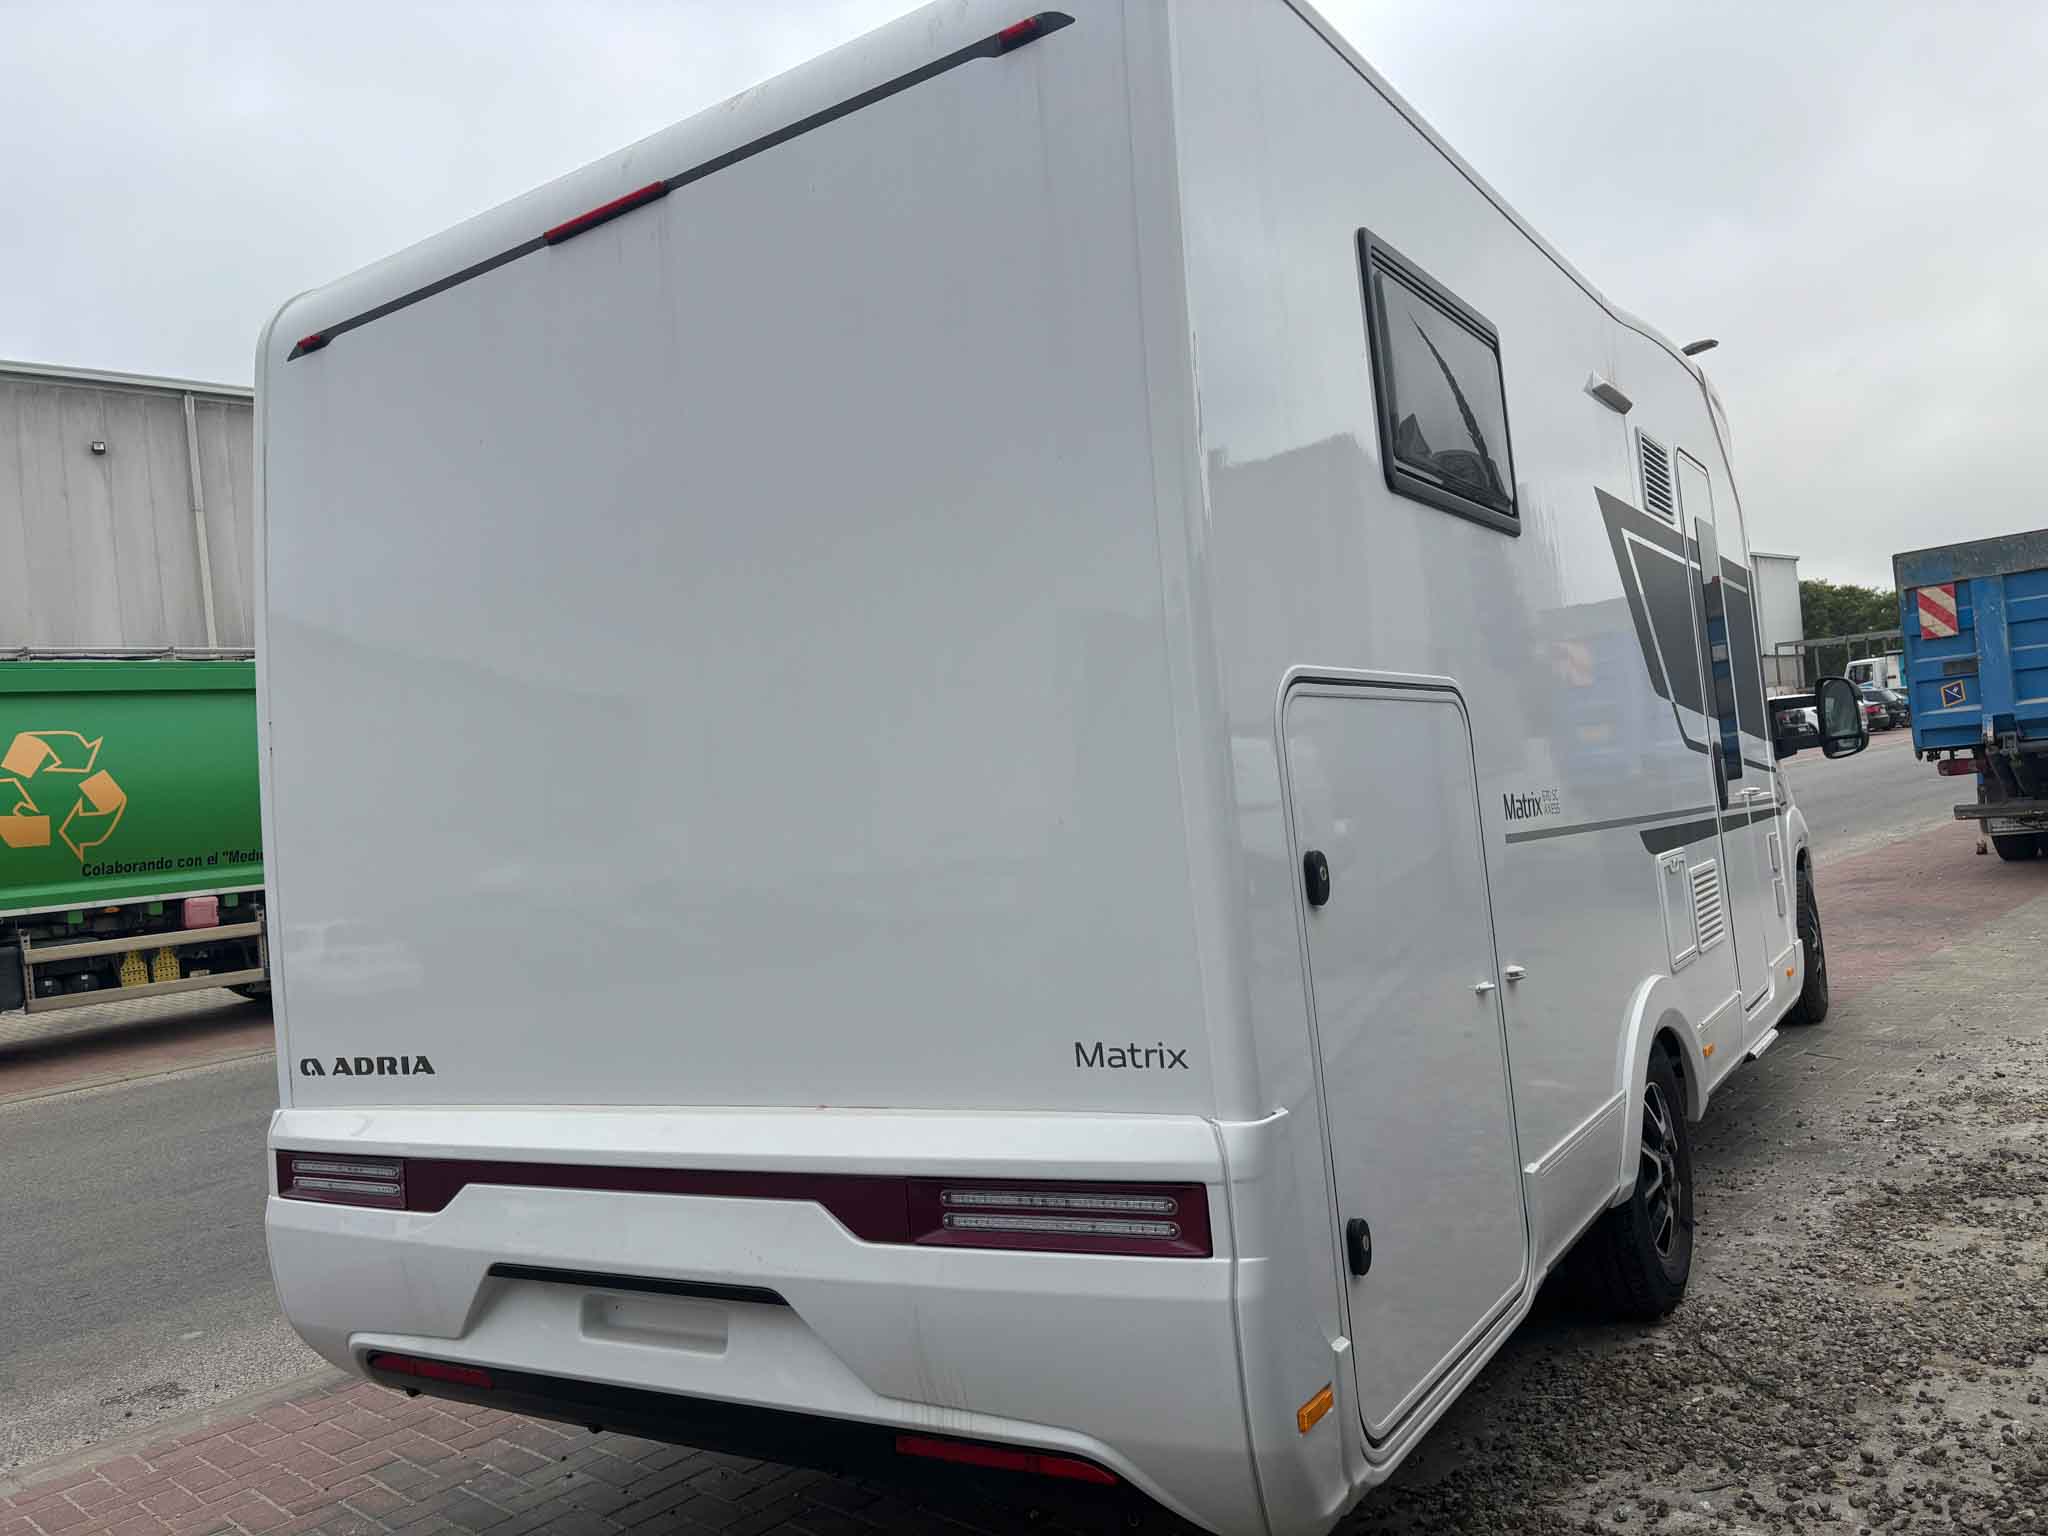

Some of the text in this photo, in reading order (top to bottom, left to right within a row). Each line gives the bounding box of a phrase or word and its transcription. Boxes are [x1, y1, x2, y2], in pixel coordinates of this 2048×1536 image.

[1503, 791, 1543, 821] Matrix
[82, 857, 173, 877] Colaborando
[177, 856, 202, 868] con
[207, 851, 218, 865] el
[332, 1055, 436, 1076] ADRIA
[1074, 1041, 1189, 1069] Matrix
